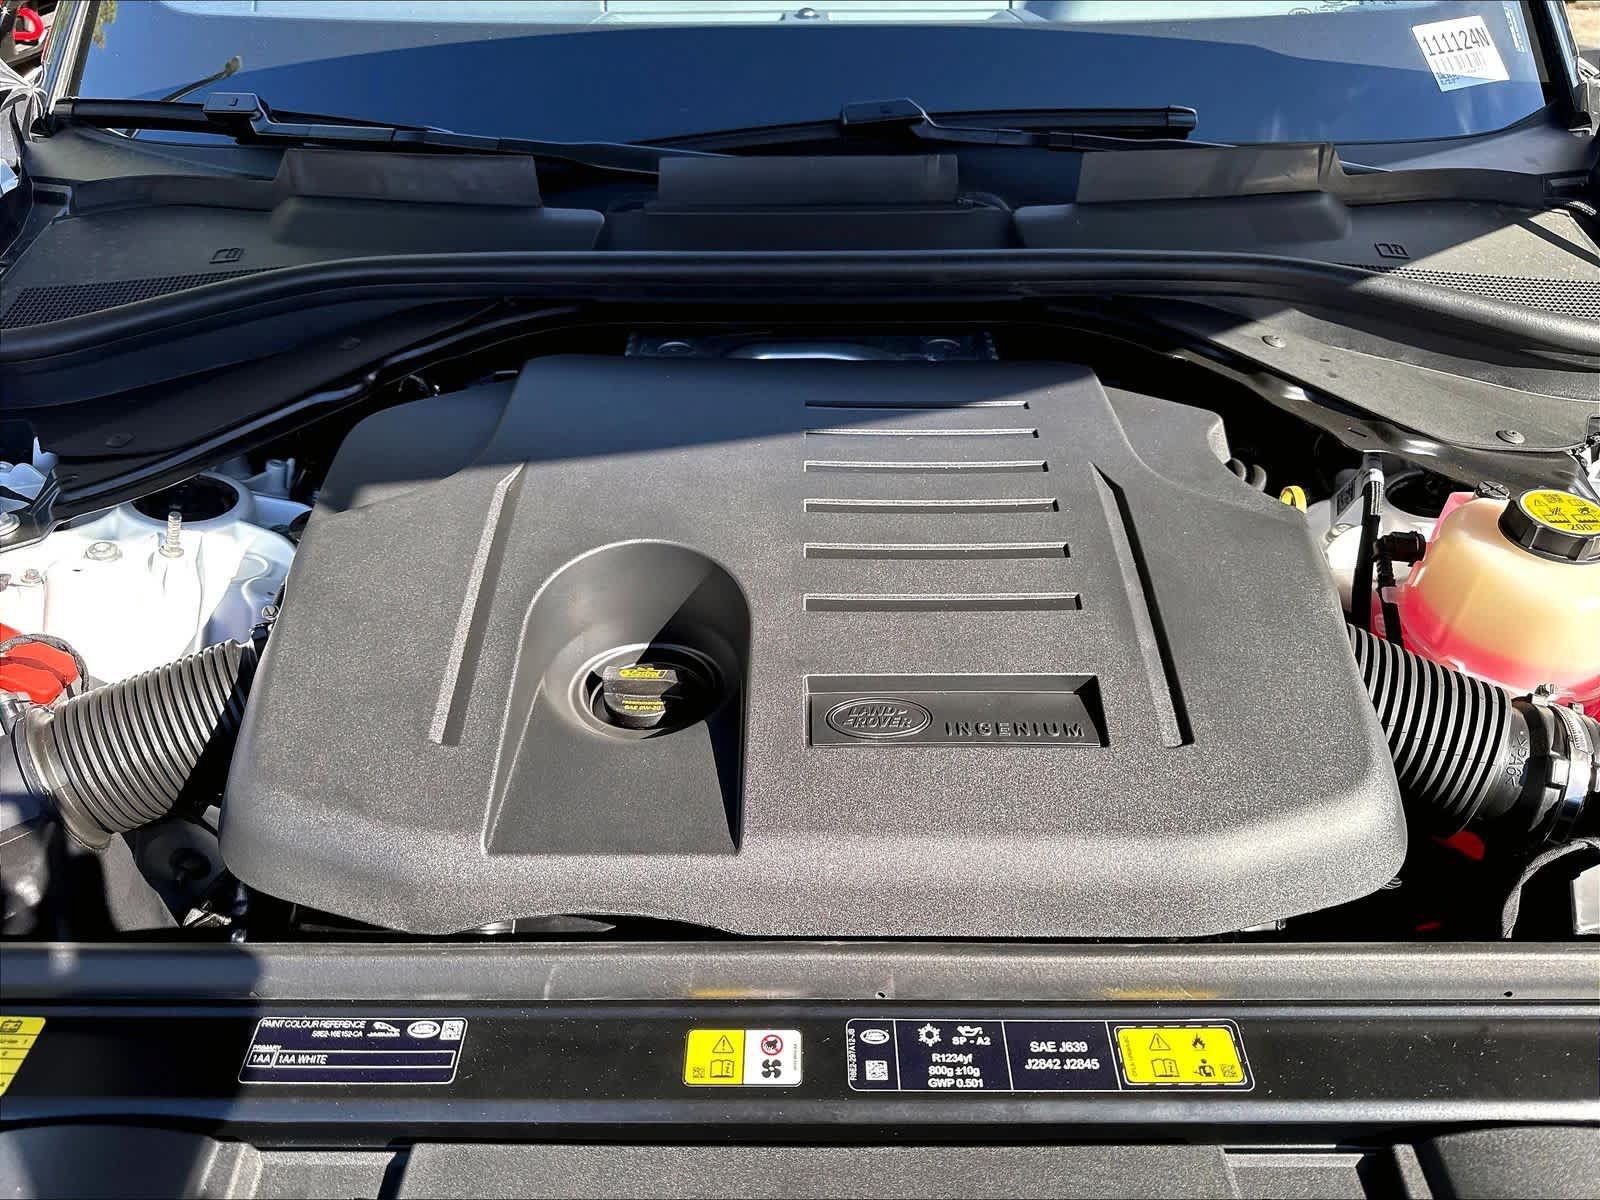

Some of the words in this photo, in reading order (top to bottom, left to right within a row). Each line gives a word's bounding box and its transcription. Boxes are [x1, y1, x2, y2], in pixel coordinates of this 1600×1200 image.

[1422, 26, 1490, 57] 111124N
[944, 721, 1085, 738] INGENIUM
[261, 1020, 286, 1029] PAINT
[285, 1020, 319, 1029] COLOUR
[320, 1020, 367, 1029] REFERENCE
[952, 1037, 966, 1046] SP
[976, 1037, 991, 1045] A2
[1029, 1041, 1057, 1052] SAE
[1059, 1041, 1088, 1052] J639
[252, 1054, 271, 1063] 1AA
[279, 1054, 296, 1064] 1AA
[298, 1054, 328, 1064] WHITE
[931, 1053, 973, 1064] R1234yf
[1024, 1058, 1061, 1070] J2842
[1063, 1058, 1100, 1070] J2845
[928, 1078, 955, 1088] GWP
[956, 1078, 984, 1088] 0.501
